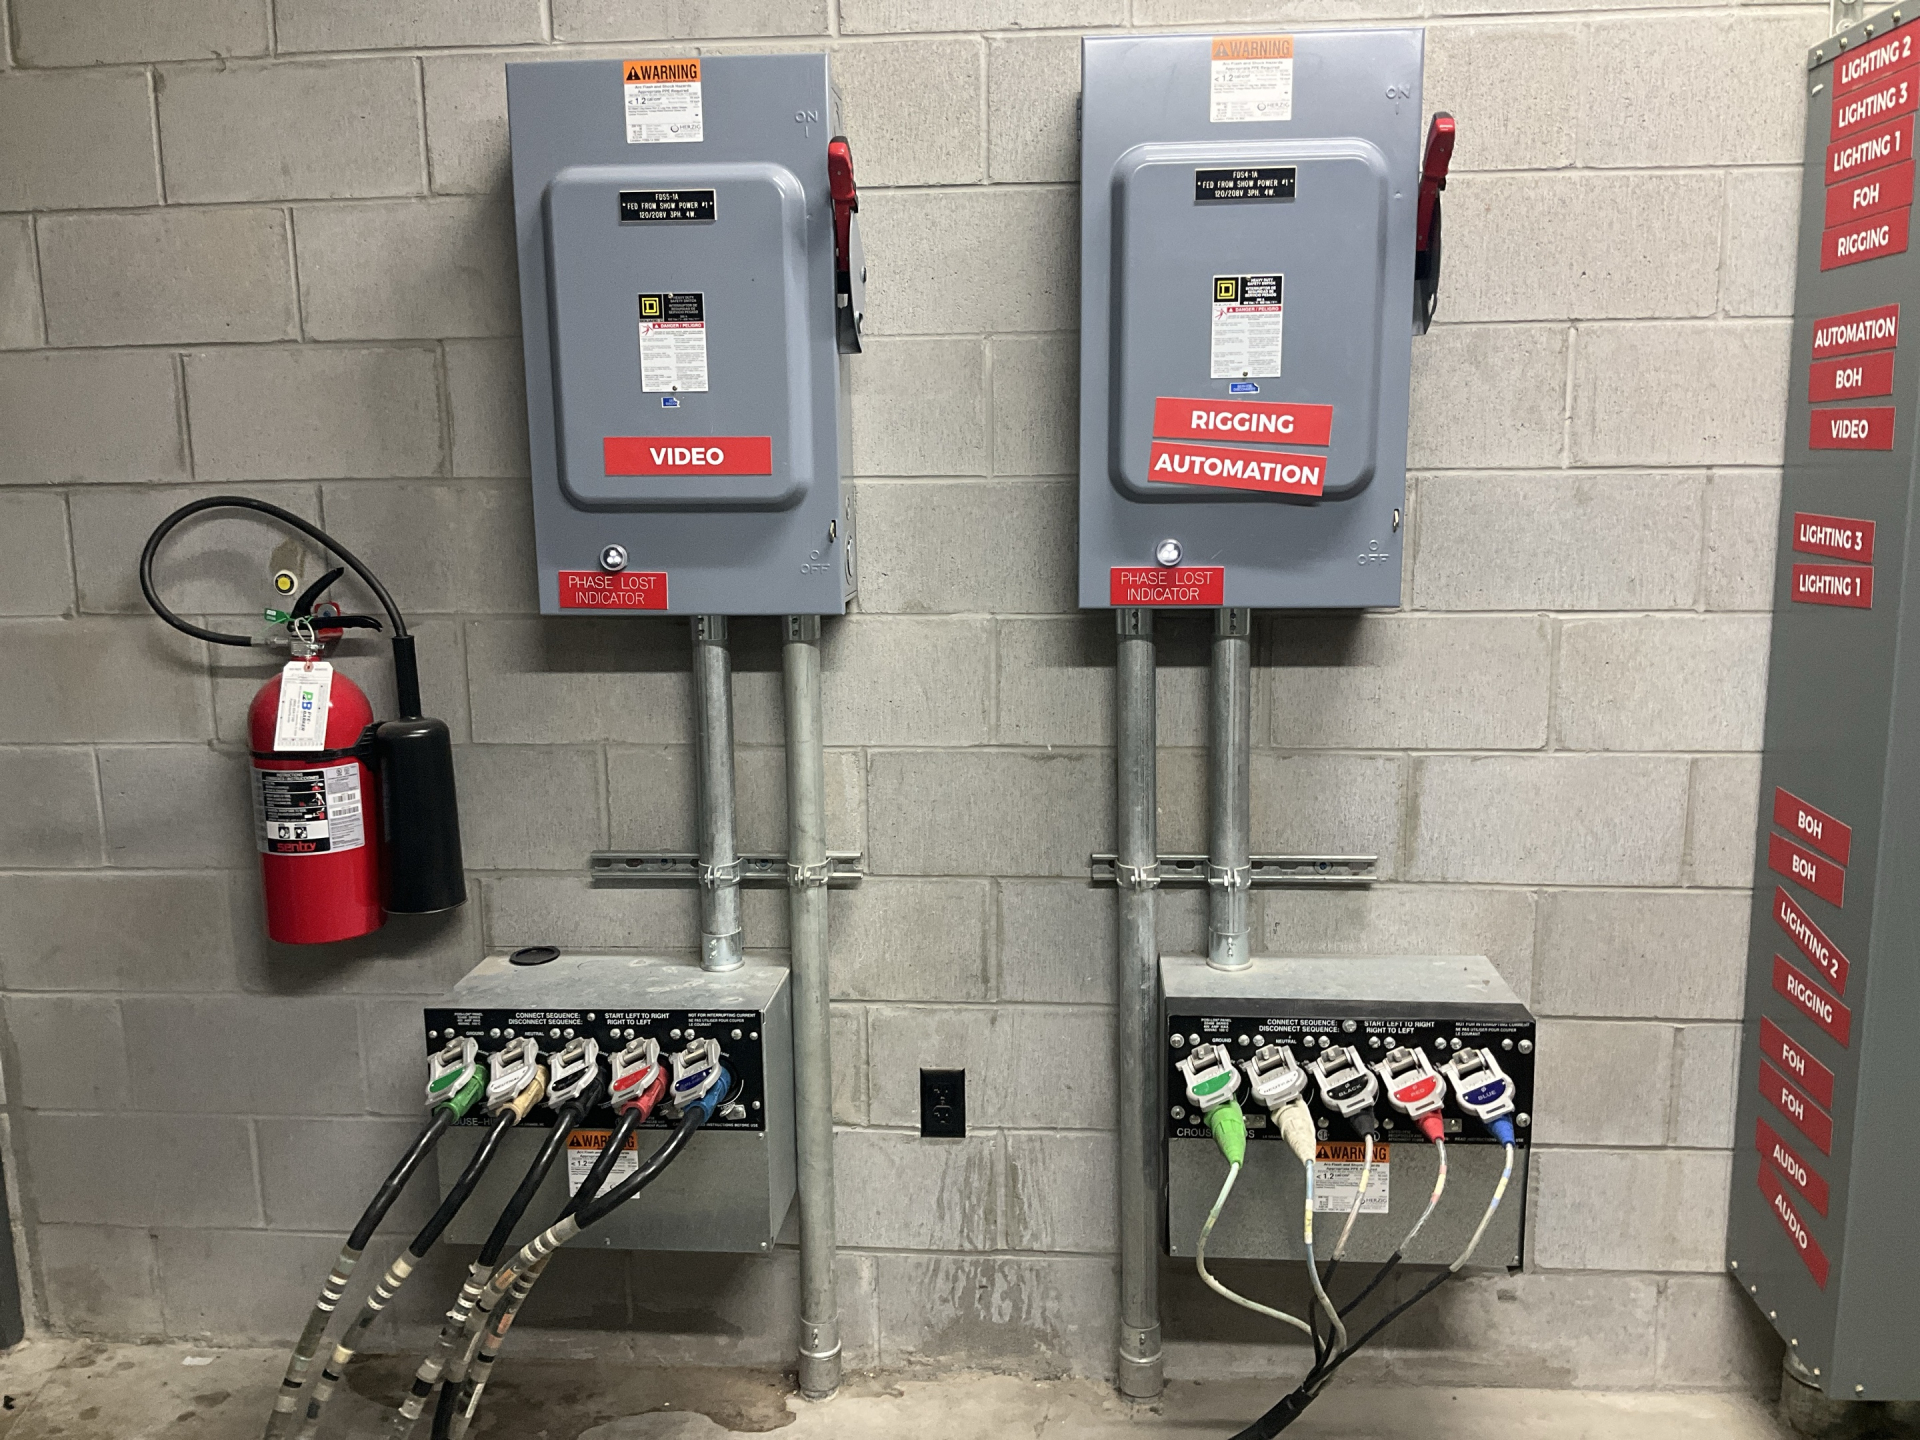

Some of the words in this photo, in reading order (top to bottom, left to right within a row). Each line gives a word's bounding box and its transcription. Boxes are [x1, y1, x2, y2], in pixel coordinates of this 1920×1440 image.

[1230, 40, 1289, 56] WARNING
[1842, 41, 1899, 84] LIGHTING
[1902, 36, 1911, 58] 2
[641, 64, 697, 80] WARNING
[1386, 84, 1410, 99] ON
[1839, 91, 1896, 127] LIGHTING
[1899, 82, 1908, 104] 3
[795, 110, 818, 123] ON
[1834, 134, 1891, 172] LIGHTING
[1894, 131, 1901, 151] 1
[1853, 183, 1879, 209] FOH
[1838, 226, 1889, 256] RIGGING
[1815, 317, 1895, 348] AUTOMATION
[1836, 367, 1862, 389] BOH
[1191, 411, 1294, 433] RIGGING
[1831, 420, 1868, 438] VIDEO
[650, 448, 724, 465] VIDEO
[1154, 454, 1319, 485] AUTOMATION
[1800, 524, 1852, 548] LIGHTING
[1854, 532, 1862, 550] 3
[800, 563, 830, 574] OFF
[1357, 553, 1389, 566] OFF
[569, 576, 613, 589] PHASE
[621, 577, 656, 589] LOST
[1121, 572, 1167, 585] PHASE
[1176, 572, 1212, 585] LOST
[1800, 574, 1851, 595] LIGHTING
[1856, 578, 1860, 596] 1
[575, 592, 645, 605] INDICATOR
[1127, 588, 1199, 601] INDICATOR
[1798, 810, 1822, 839] BOH
[277, 841, 316, 852] sentry
[1792, 854, 1816, 882] BOH
[1781, 902, 1828, 965] LIGHTING
[1831, 959, 1839, 978] 2
[1788, 974, 1832, 1023] RIGGING
[1783, 1044, 1805, 1076] FOH
[1339, 1084, 1361, 1096] BLACK
[1411, 1088, 1425, 1097] RED
[1478, 1090, 1496, 1100] BLUE
[1782, 1088, 1804, 1121] FOH
[1330, 1146, 1386, 1160] WARNNG
[1773, 1144, 1806, 1186] AUDIO
[1775, 1194, 1807, 1249] AUDIO
